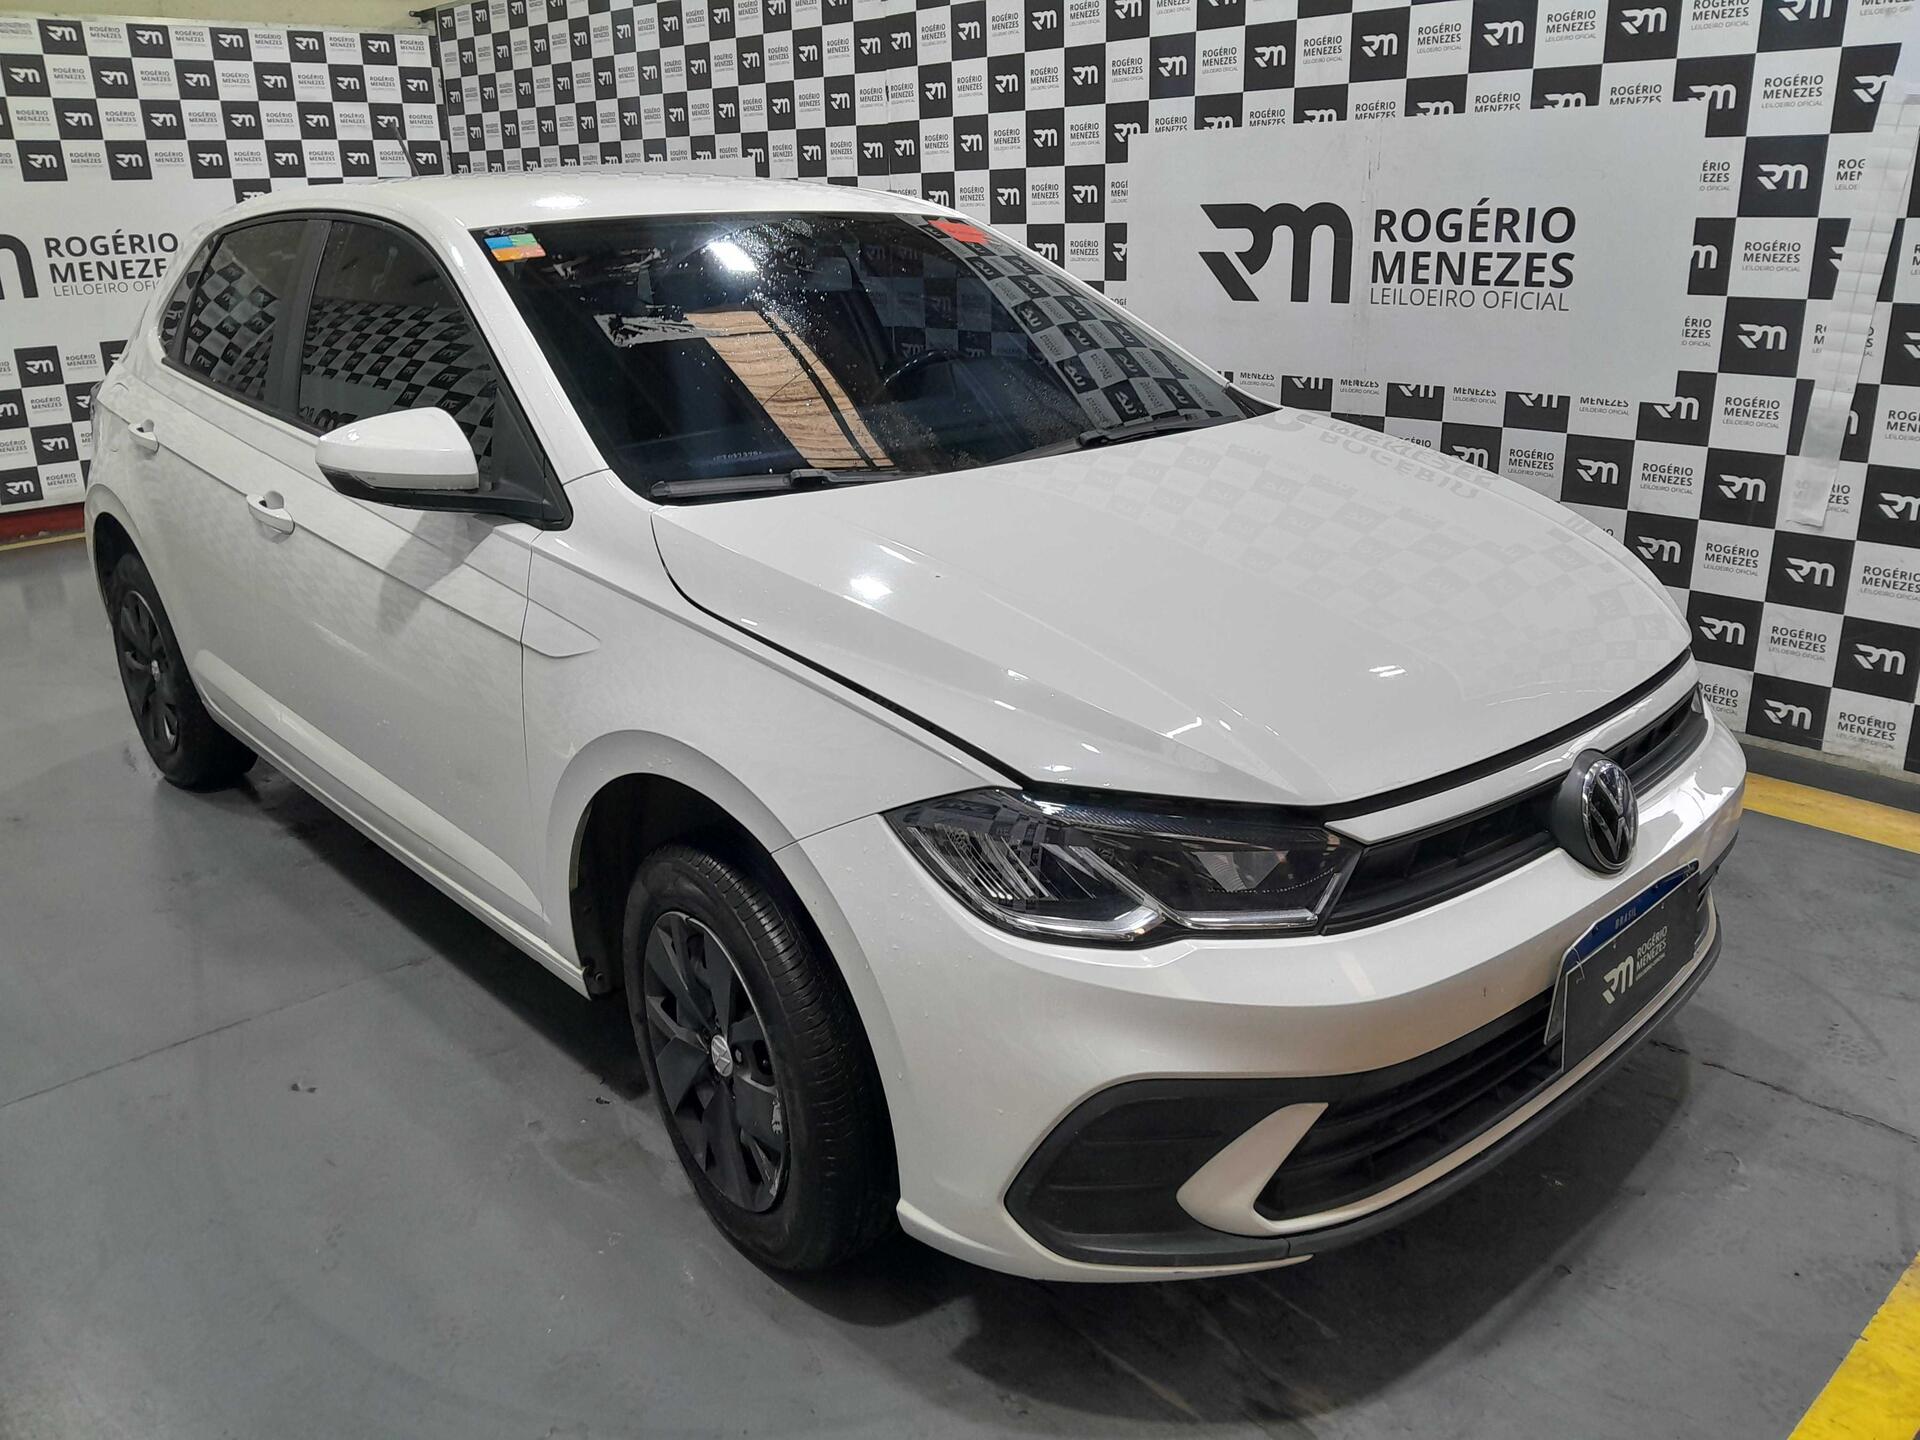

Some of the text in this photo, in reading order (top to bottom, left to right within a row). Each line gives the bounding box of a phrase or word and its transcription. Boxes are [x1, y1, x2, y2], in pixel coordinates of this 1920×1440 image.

[992, 13, 1018, 23] ROGÉRIO
[1070, 9, 1099, 20] MENEZES
[1547, 9, 1596, 23] ROGÉRIO
[1691, 6, 1748, 21] MENEZES
[921, 23, 945, 33] ROGÉRIO
[992, 21, 1019, 31] MENEZES
[1418, 23, 1461, 36] ROGÉRIO
[1545, 20, 1595, 34] MENEZES
[921, 31, 946, 41] MENEZES
[1304, 36, 1342, 48] ROGÉRIO
[1416, 33, 1461, 46] MENEZES
[1202, 47, 1236, 58] ROGÉRIO
[1303, 45, 1342, 57] MENEZES
[1112, 57, 1142, 68] ROGÉRIO
[1202, 56, 1237, 67] MENEZES
[1030, 67, 1058, 76] ROGÉRIO
[1111, 66, 1143, 76] MENEZES
[957, 75, 982, 84] ROGÉRIO
[1030, 75, 1058, 84] MENEZES
[1764, 74, 1823, 87] ROGÉRIO
[957, 83, 982, 92] MENEZES
[1610, 83, 1662, 96] ROGÉRIO
[1762, 86, 1822, 99] MENEZES
[1475, 92, 1520, 104] ROGÉRIO
[1355, 101, 1396, 112] ROGÉRIO
[1249, 109, 1285, 119] ROGÉRIO
[1070, 122, 1099, 131] ROGÉRIO
[1155, 116, 1187, 126] ROGÉRIO
[925, 133, 948, 141] ROGÉRIO
[994, 128, 1020, 137] ROGÉRIO
[1070, 131, 1099, 139] MENEZES
[925, 141, 949, 149] MENEZES
[994, 136, 1020, 144] MENEZES
[960, 185, 984, 193] ROGÉRIO
[1032, 182, 1059, 191] ROGÉRIO
[1373, 198, 1576, 244] ROGÉRIO
[44, 229, 178, 258] ROGÉRIO
[1071, 238, 1099, 246] ROGÉRIO
[1744, 240, 1801, 252] ROGÉRIO
[1742, 253, 1800, 263] MENEZES
[49, 258, 167, 284] MENEZE
[1370, 250, 1574, 289] MENEZES
[53, 281, 129, 297] LEILOEIRO
[1370, 287, 1570, 312] LEILOEIRO OFICIAL
[1724, 397, 1780, 409] ROGÉRIO
[1722, 407, 1778, 420] MENEZES
[1509, 449, 1554, 461] ROGÉRIO
[1508, 458, 1553, 470] MENEZES
[1642, 463, 1693, 476] ROGÉRIO
[1640, 473, 1692, 486] MENEZES
[1705, 543, 1758, 558] ROGÉRIO
[1703, 552, 1757, 568] MENEZES
[1860, 575, 1920, 593] MENEZES
[1771, 625, 1826, 643] ROGÉRIO
[1769, 635, 1825, 653] MENEZES
[1838, 711, 1897, 731] ROGÉRIO
[1836, 721, 1895, 741] MENEZES
[1636, 925, 1668, 959] ROGÉRIO
[1636, 940, 1667, 972] MENEZES
